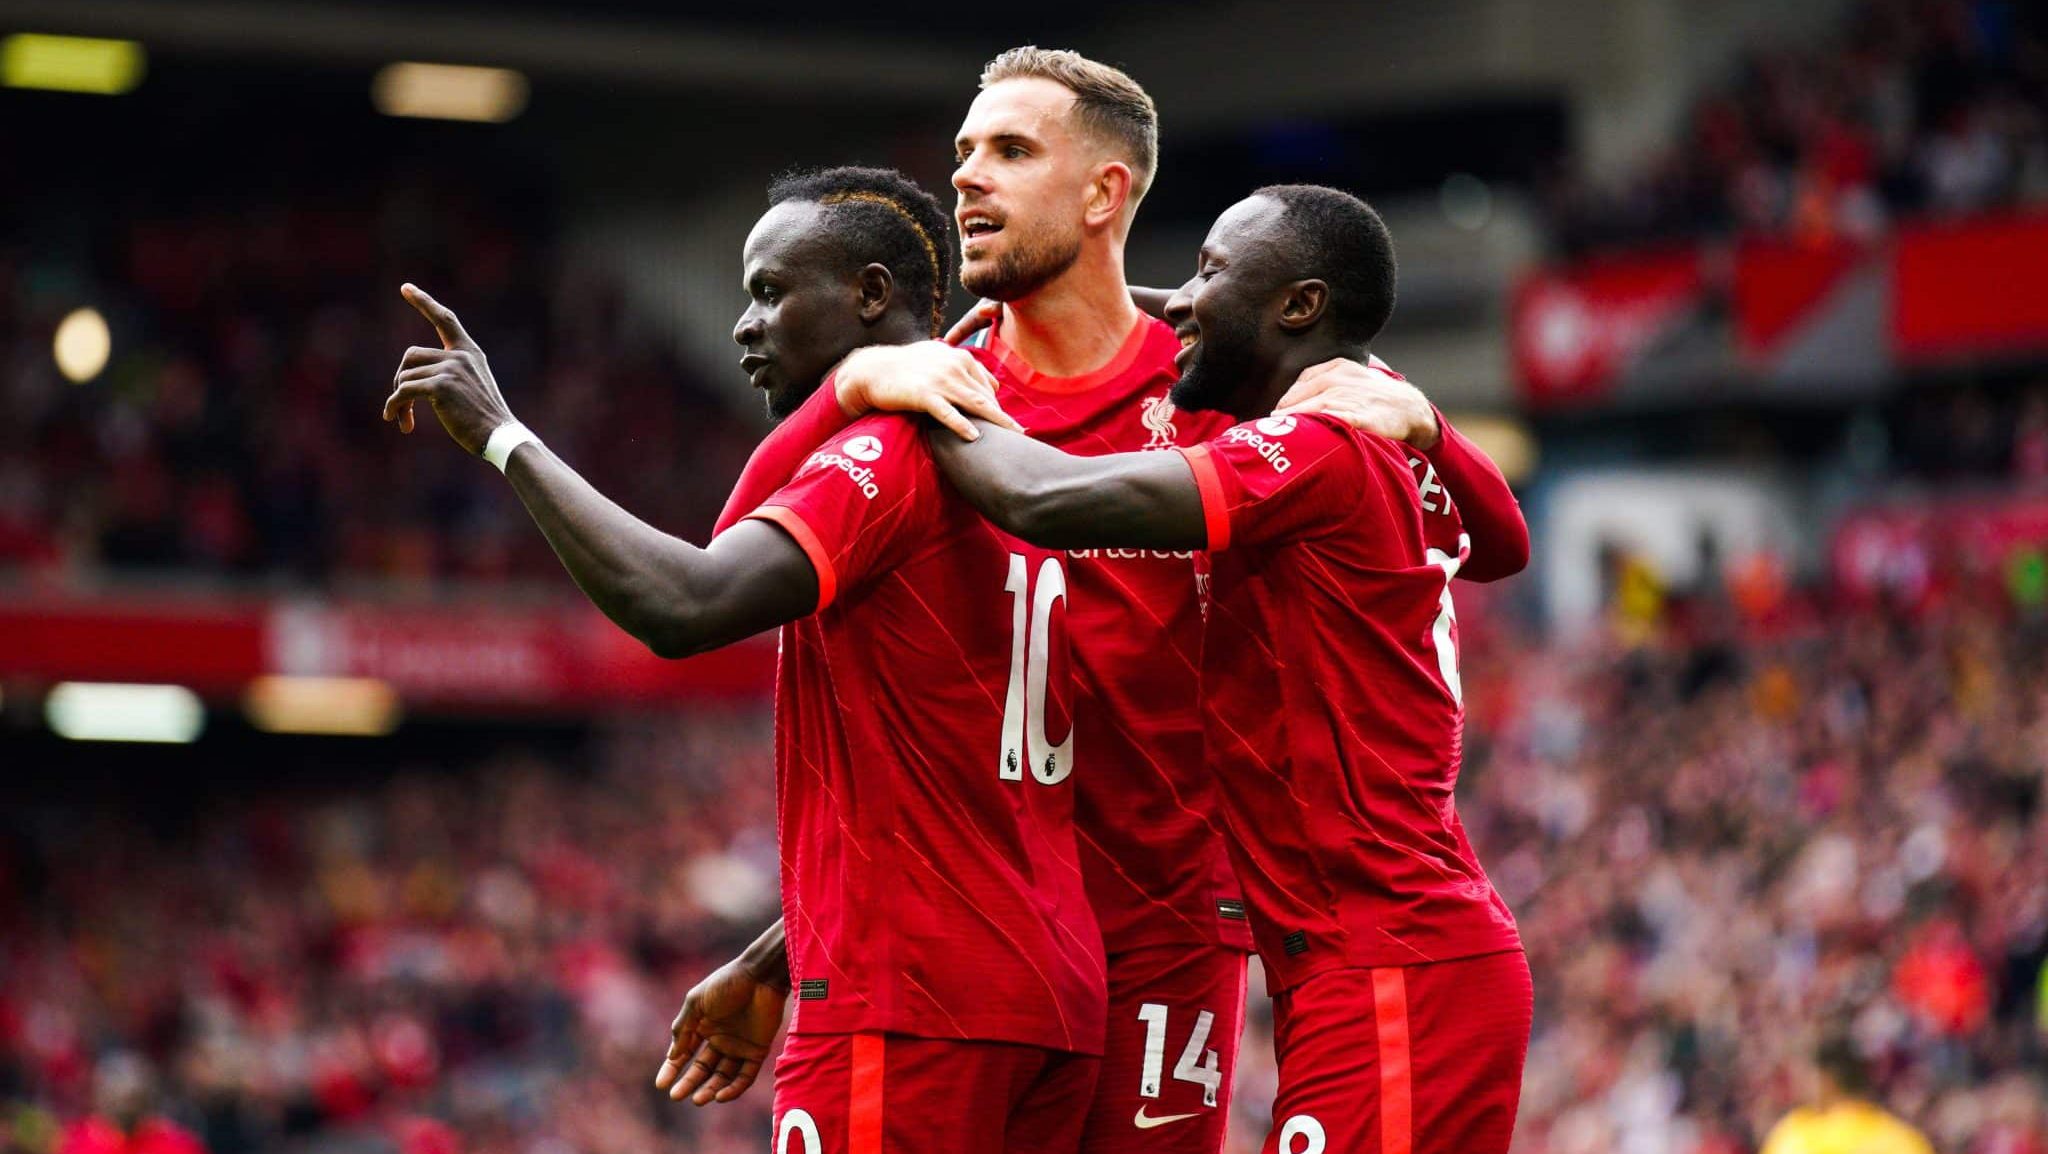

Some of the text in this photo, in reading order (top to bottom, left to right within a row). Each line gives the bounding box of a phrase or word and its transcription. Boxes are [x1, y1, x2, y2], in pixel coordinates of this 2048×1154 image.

[797, 451, 880, 500] xpedia
[1221, 425, 1292, 474] xpedia
[999, 552, 1074, 785] 10
[1137, 1003, 1223, 1108] 14
